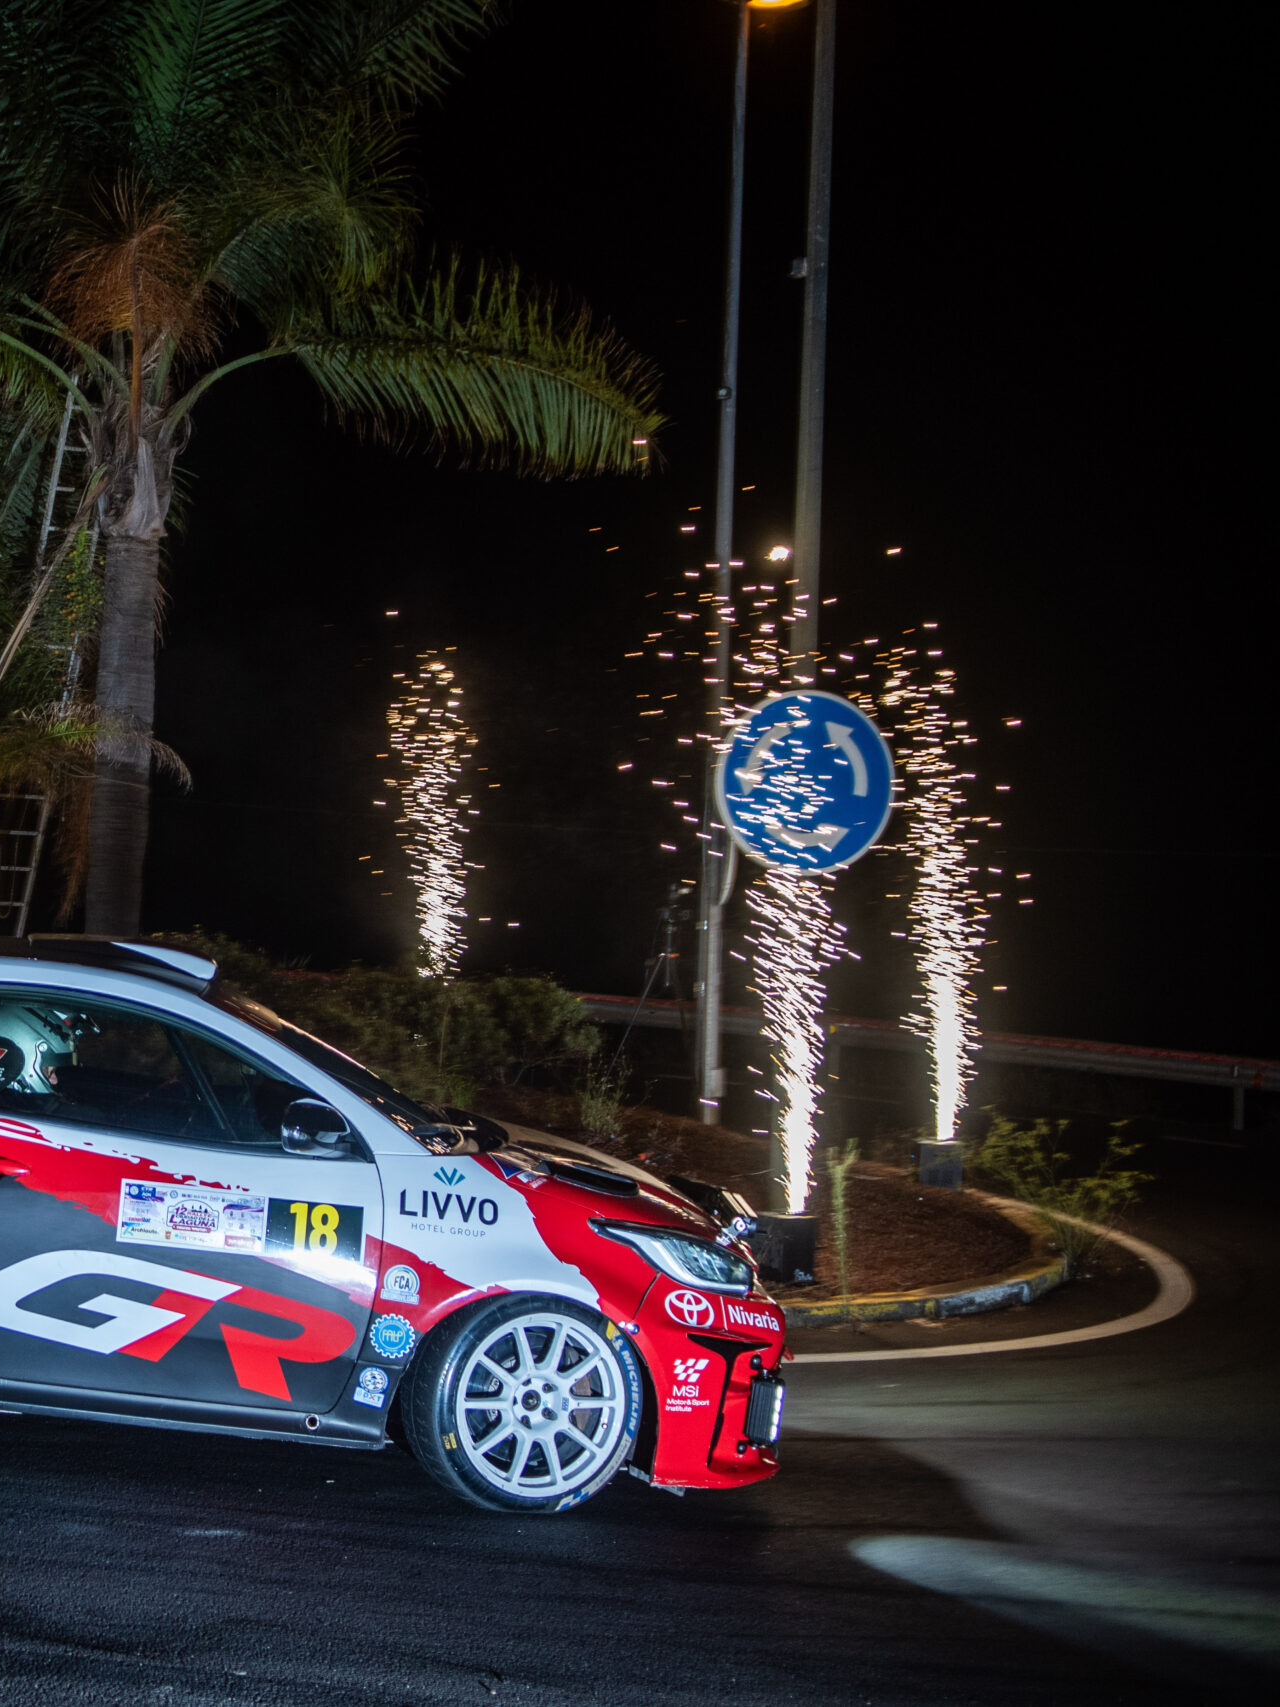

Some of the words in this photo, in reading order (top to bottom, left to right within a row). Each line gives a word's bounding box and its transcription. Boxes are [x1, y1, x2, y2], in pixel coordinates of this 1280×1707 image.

[169, 1213, 216, 1228] LAGUNA
[399, 1188, 499, 1226] LIVVO
[289, 1202, 340, 1254] 18
[411, 1222, 445, 1234] HOTEL
[450, 1226, 486, 1238] GROUP
[393, 1275, 410, 1290] FCA
[727, 1304, 781, 1332] Nivaria
[620, 1350, 638, 1431] MICHELIN
